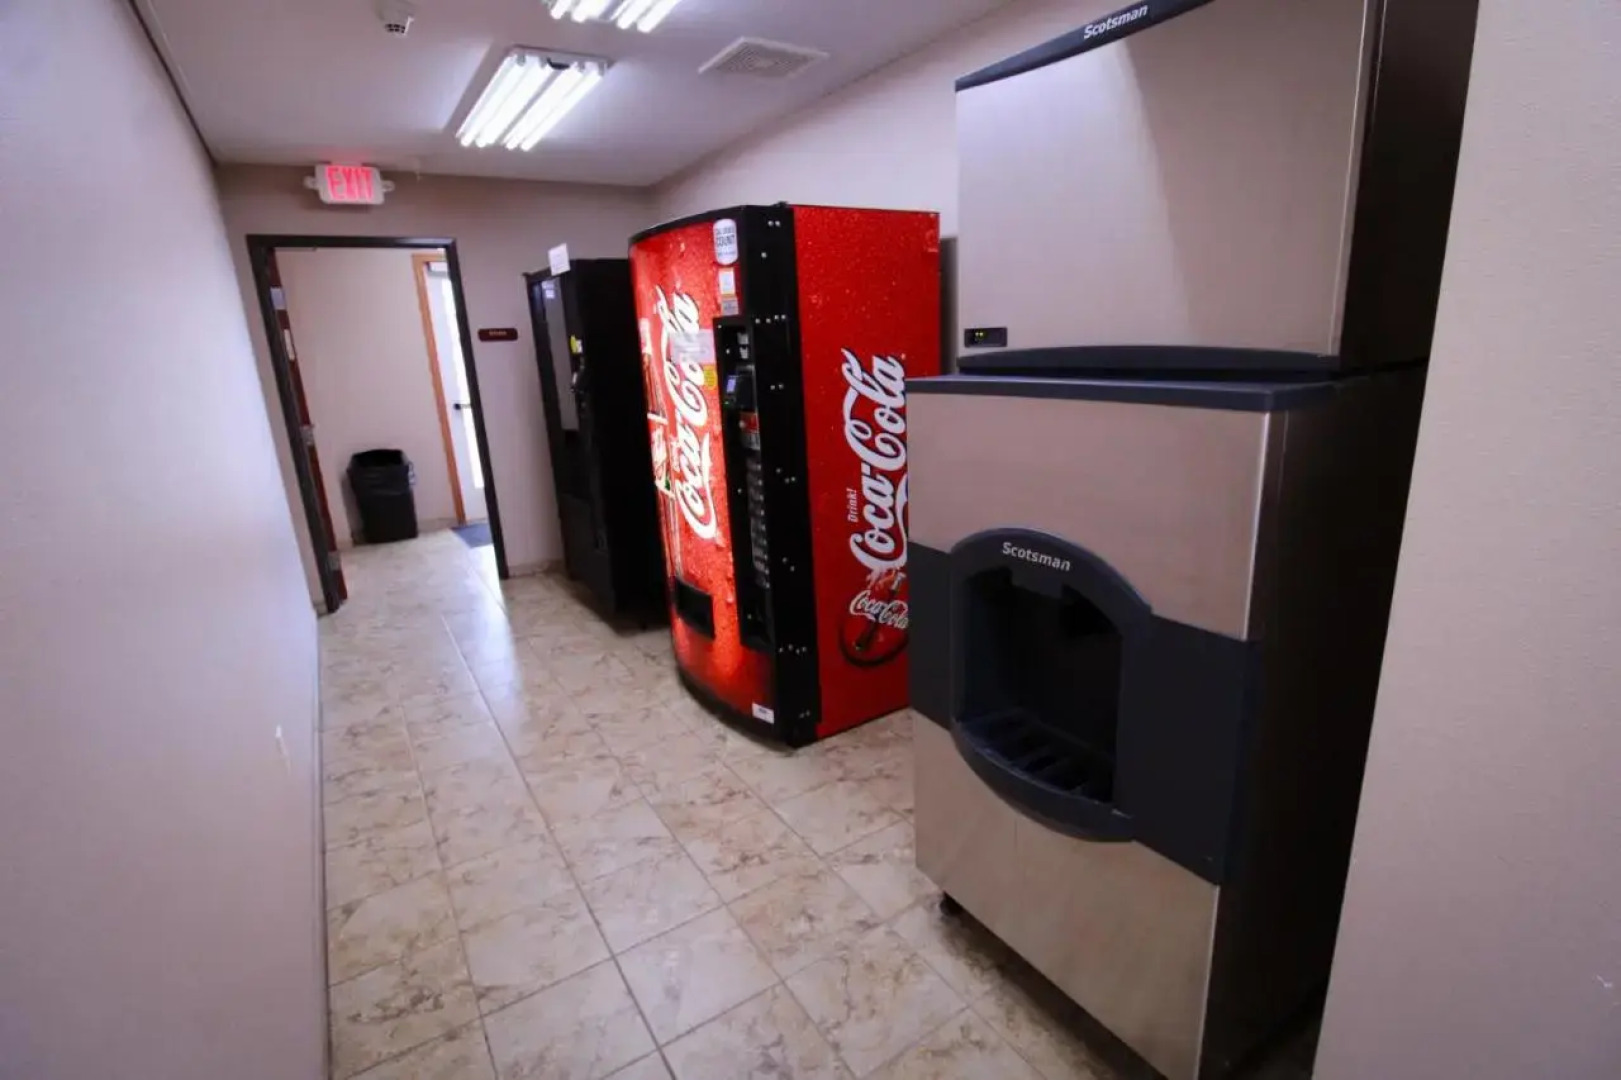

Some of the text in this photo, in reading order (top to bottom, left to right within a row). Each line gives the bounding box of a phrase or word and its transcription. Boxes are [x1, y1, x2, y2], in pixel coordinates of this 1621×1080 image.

[1083, 5, 1148, 39] Scotsman
[327, 166, 373, 200] EXIT
[842, 348, 907, 571] Coca-Cola
[847, 488, 858, 523] Drink!
[1002, 541, 1071, 571] Scotsman
